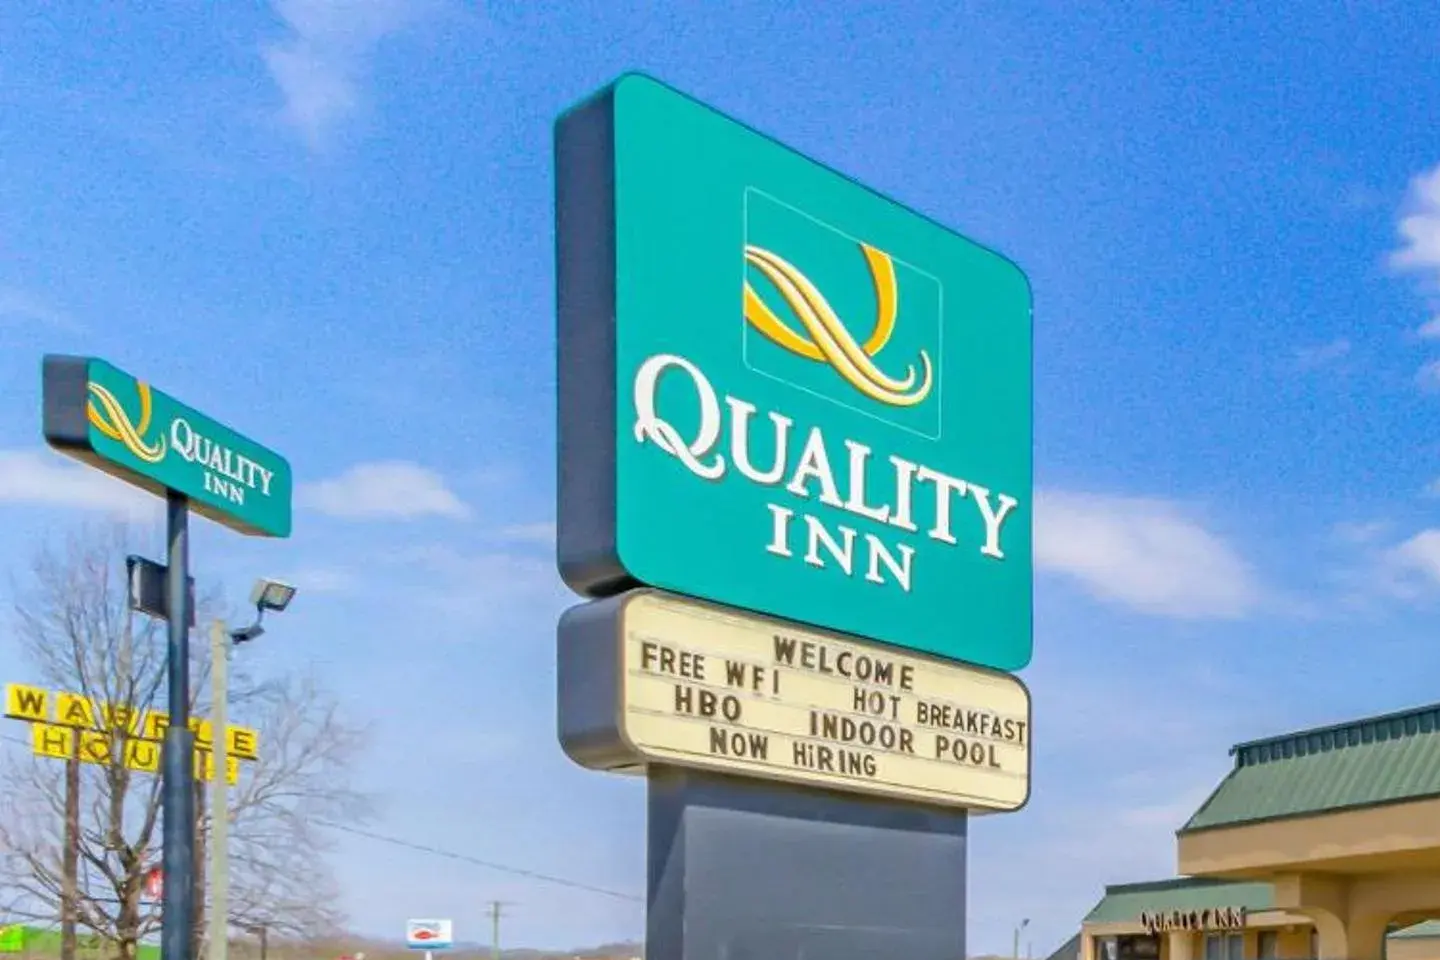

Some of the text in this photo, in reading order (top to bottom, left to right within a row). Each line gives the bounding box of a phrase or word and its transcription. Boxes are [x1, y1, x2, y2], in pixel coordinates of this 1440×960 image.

[171, 418, 274, 496] QUALITY
[634, 353, 1018, 559] QUALITY
[204, 471, 244, 505] INN
[765, 502, 914, 592] INN
[641, 641, 705, 681] FREE
[773, 634, 914, 691] WELCOME
[674, 684, 742, 731] HBO
[853, 687, 1027, 744] HOT BREAKFAST
[709, 726, 769, 761] NOW
[810, 710, 1001, 768] INDOOR POOL
